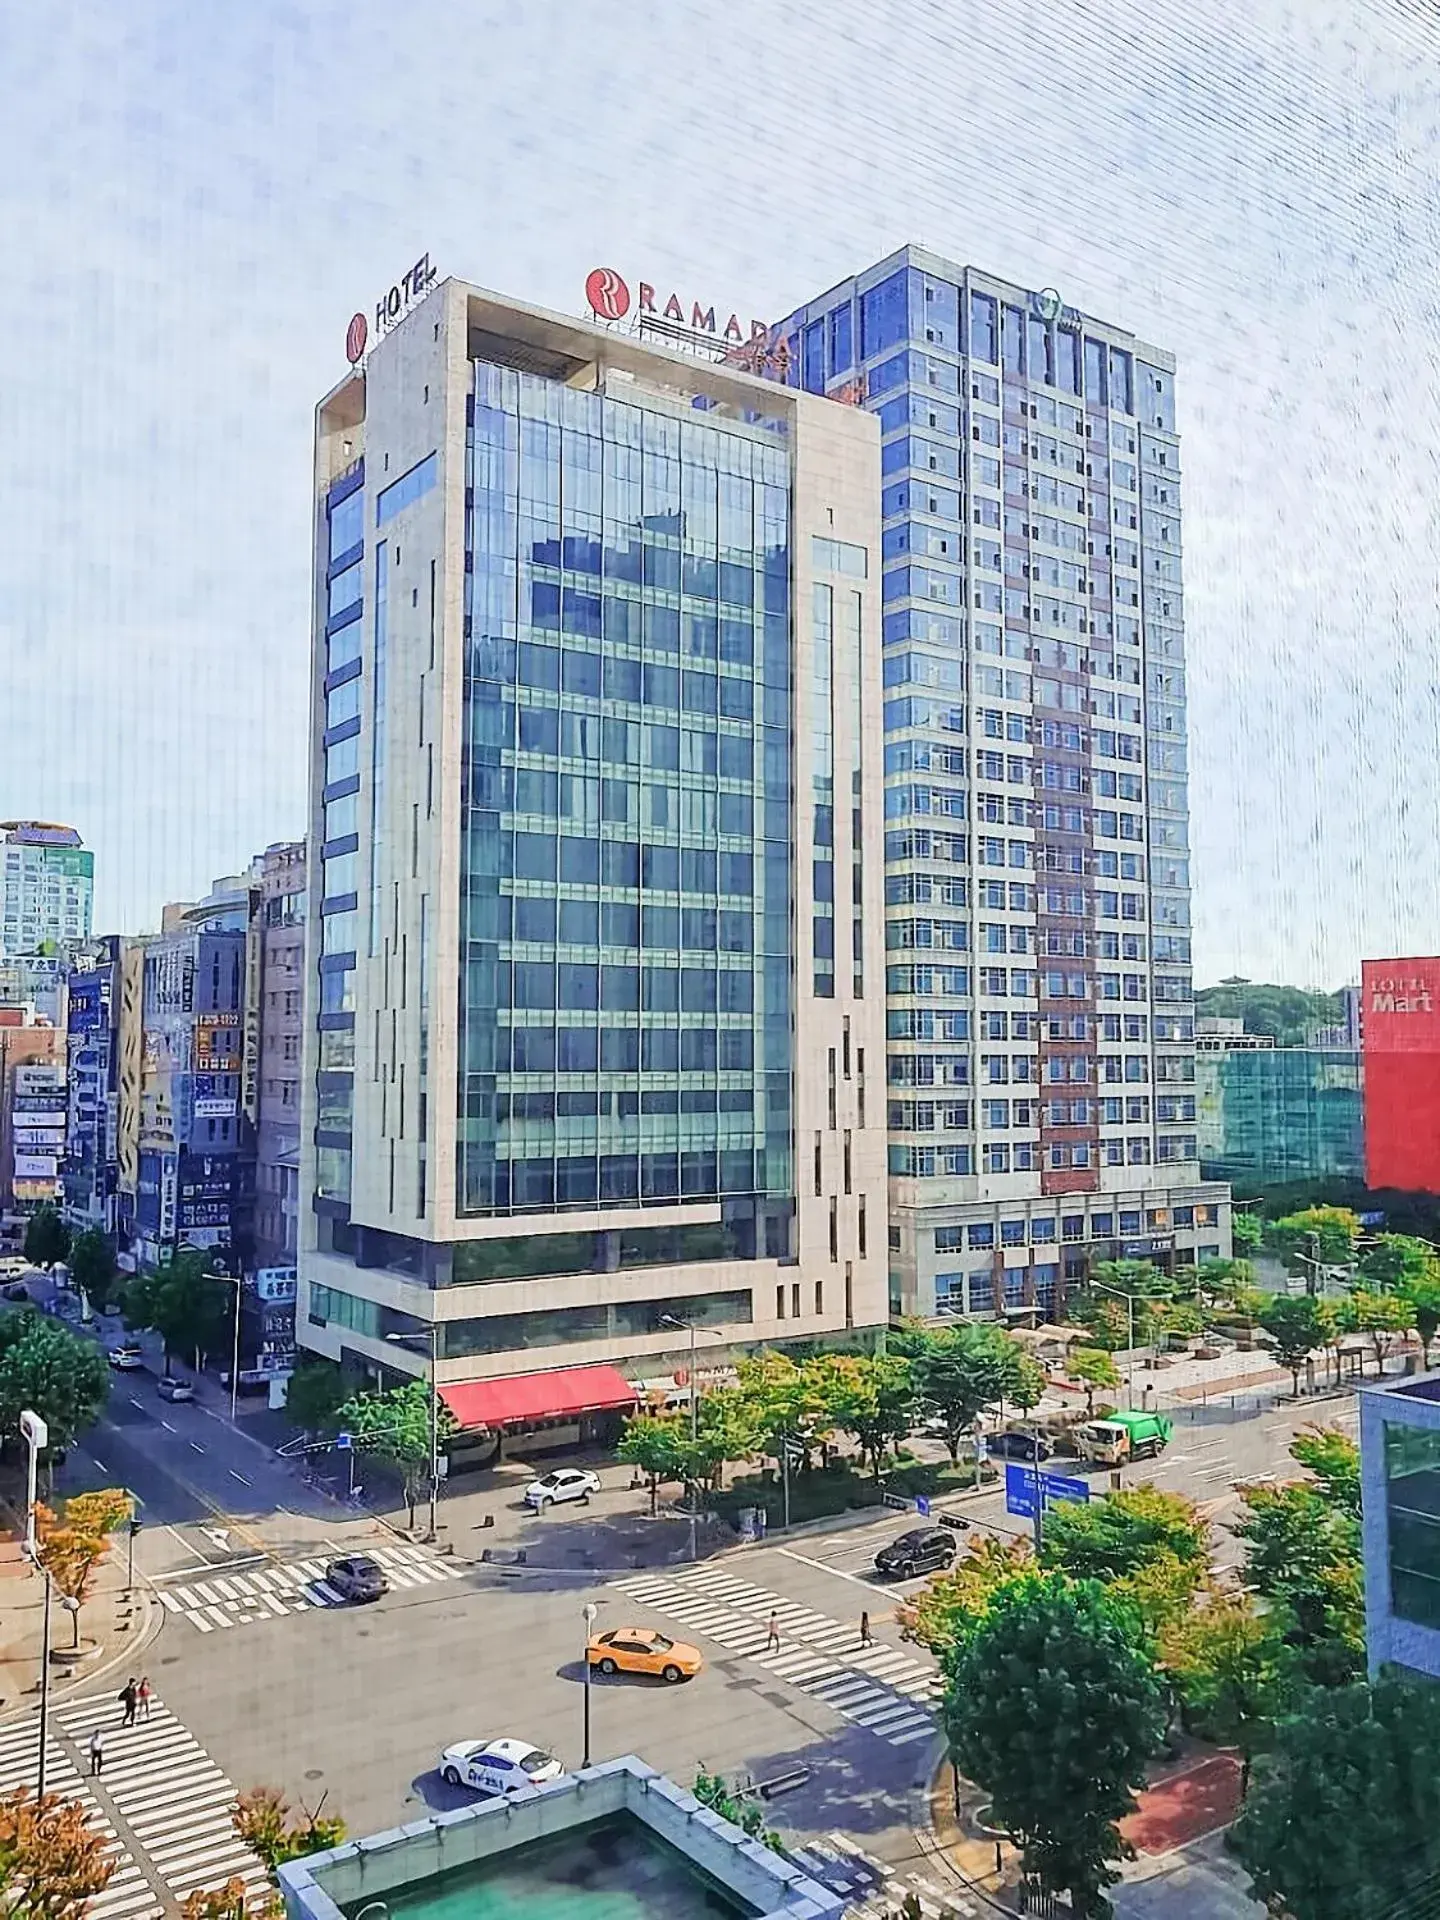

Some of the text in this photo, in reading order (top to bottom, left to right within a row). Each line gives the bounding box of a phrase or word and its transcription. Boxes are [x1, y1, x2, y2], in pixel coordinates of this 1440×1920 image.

[375, 252, 437, 334] HOTEL
[639, 282, 791, 358] RAMADA
[1371, 992, 1433, 1013] Mart
